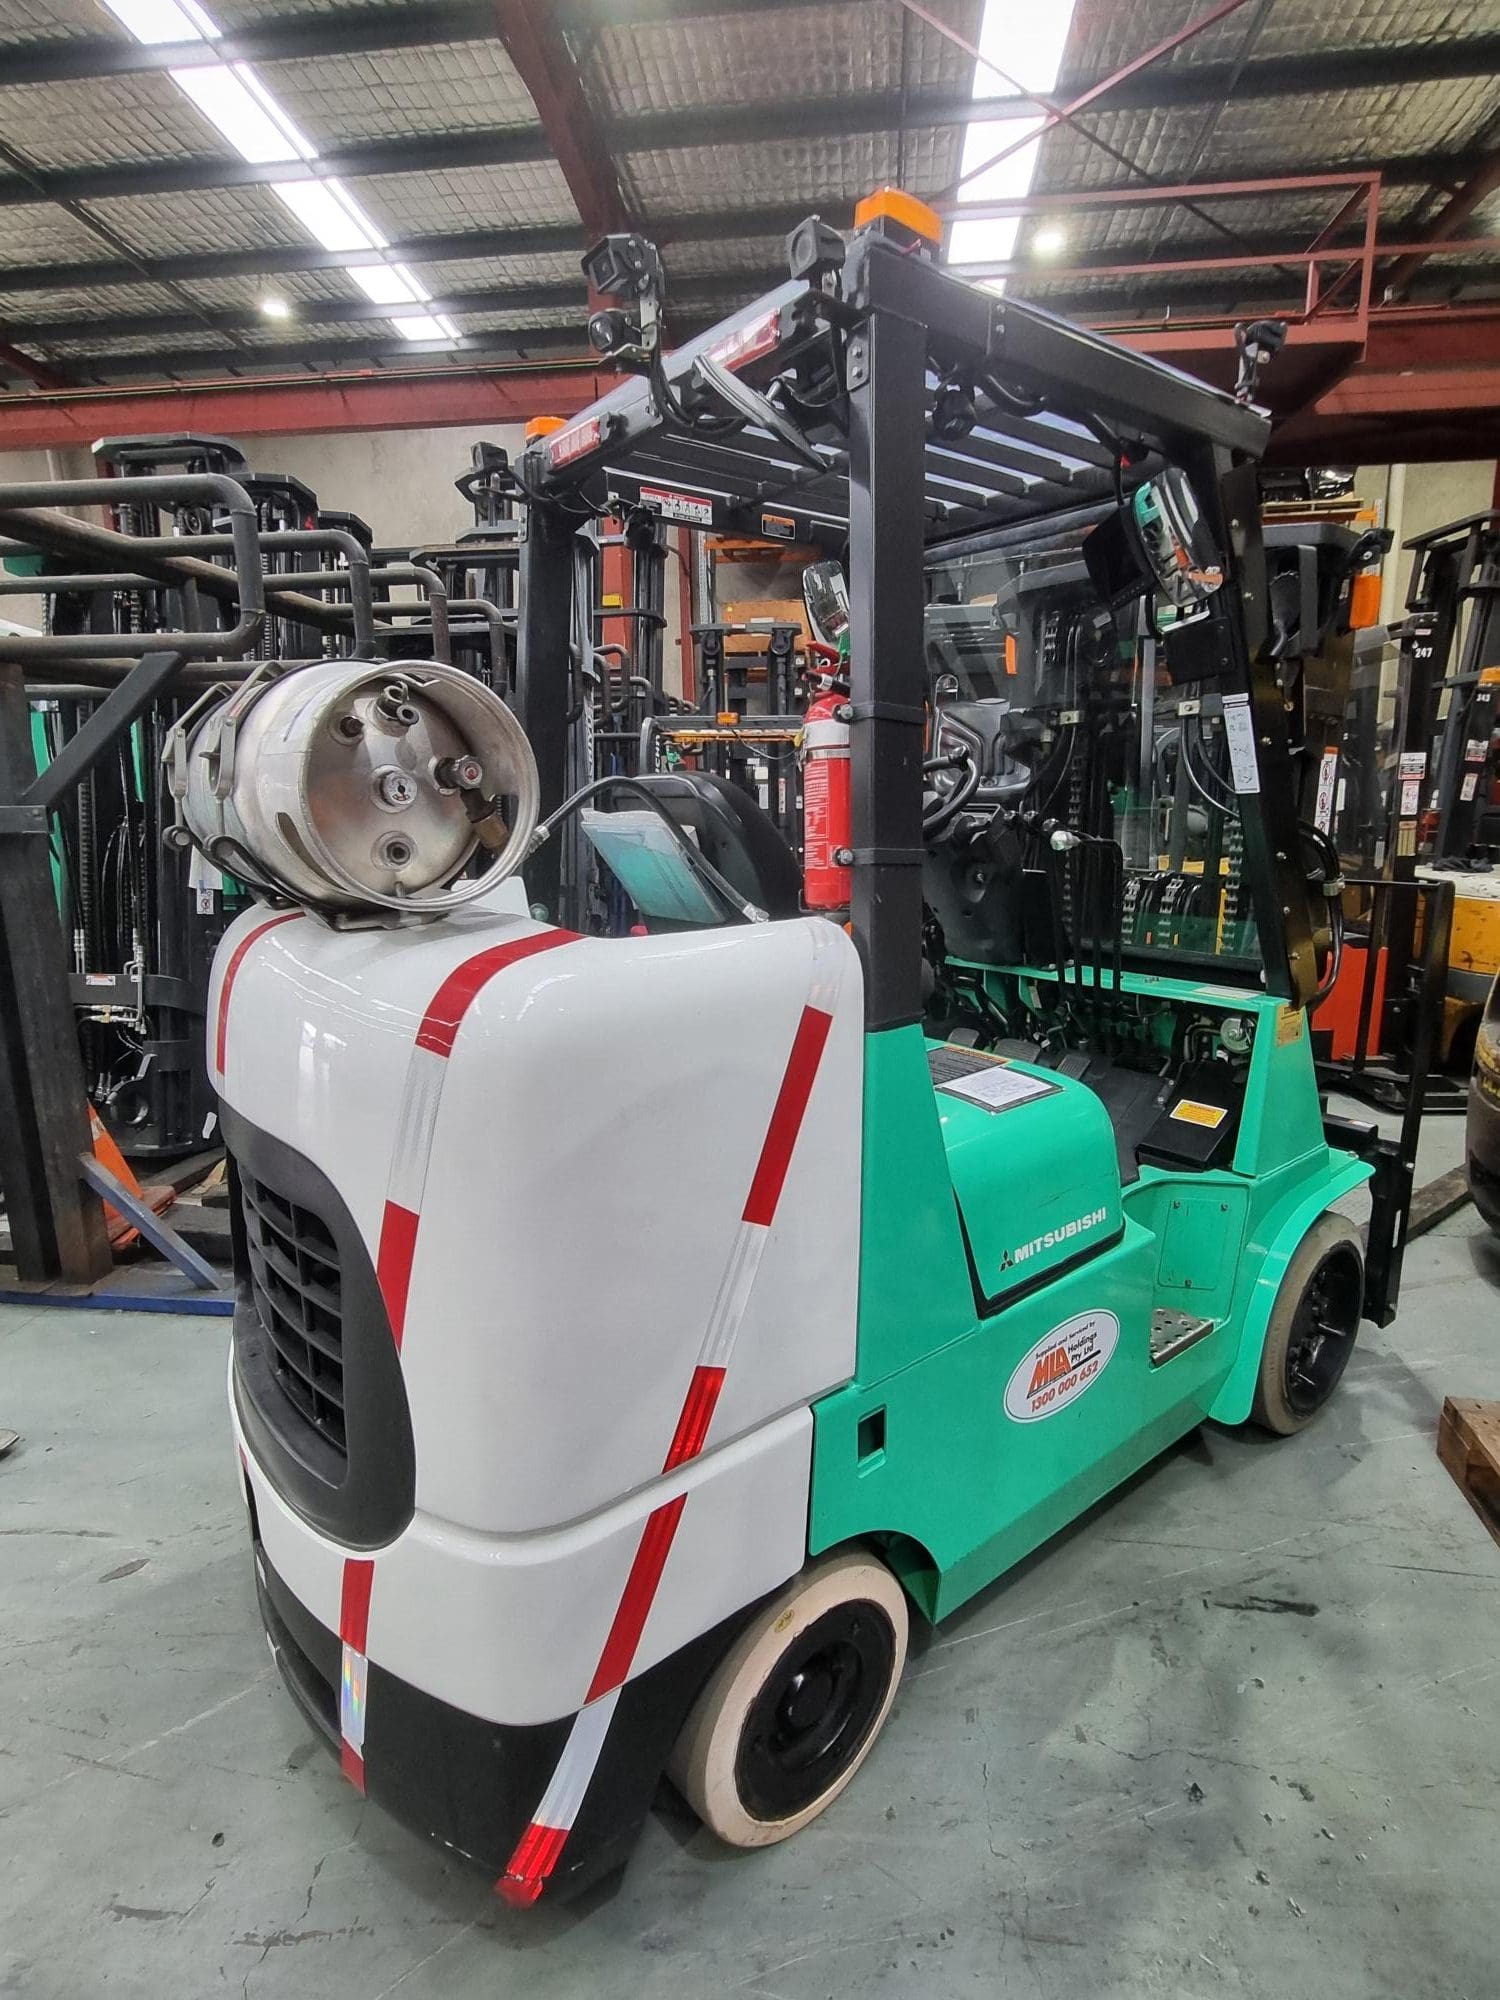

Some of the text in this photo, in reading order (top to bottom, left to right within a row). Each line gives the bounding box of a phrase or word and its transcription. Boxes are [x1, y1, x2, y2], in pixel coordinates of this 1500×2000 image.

[1415, 647, 1433, 658] 247
[1014, 1206, 1106, 1264] MITSUBISHI
[1035, 1343, 1057, 1360] Supplied
[1058, 1336, 1068, 1345] and
[1069, 1325, 1088, 1338] Serviced
[1068, 1331, 1098, 1354] Holdings
[1071, 1344, 1094, 1364] Pty Ltd
[1028, 1346, 1072, 1394] MLA
[1031, 1360, 1099, 1413] 1300 000 652
